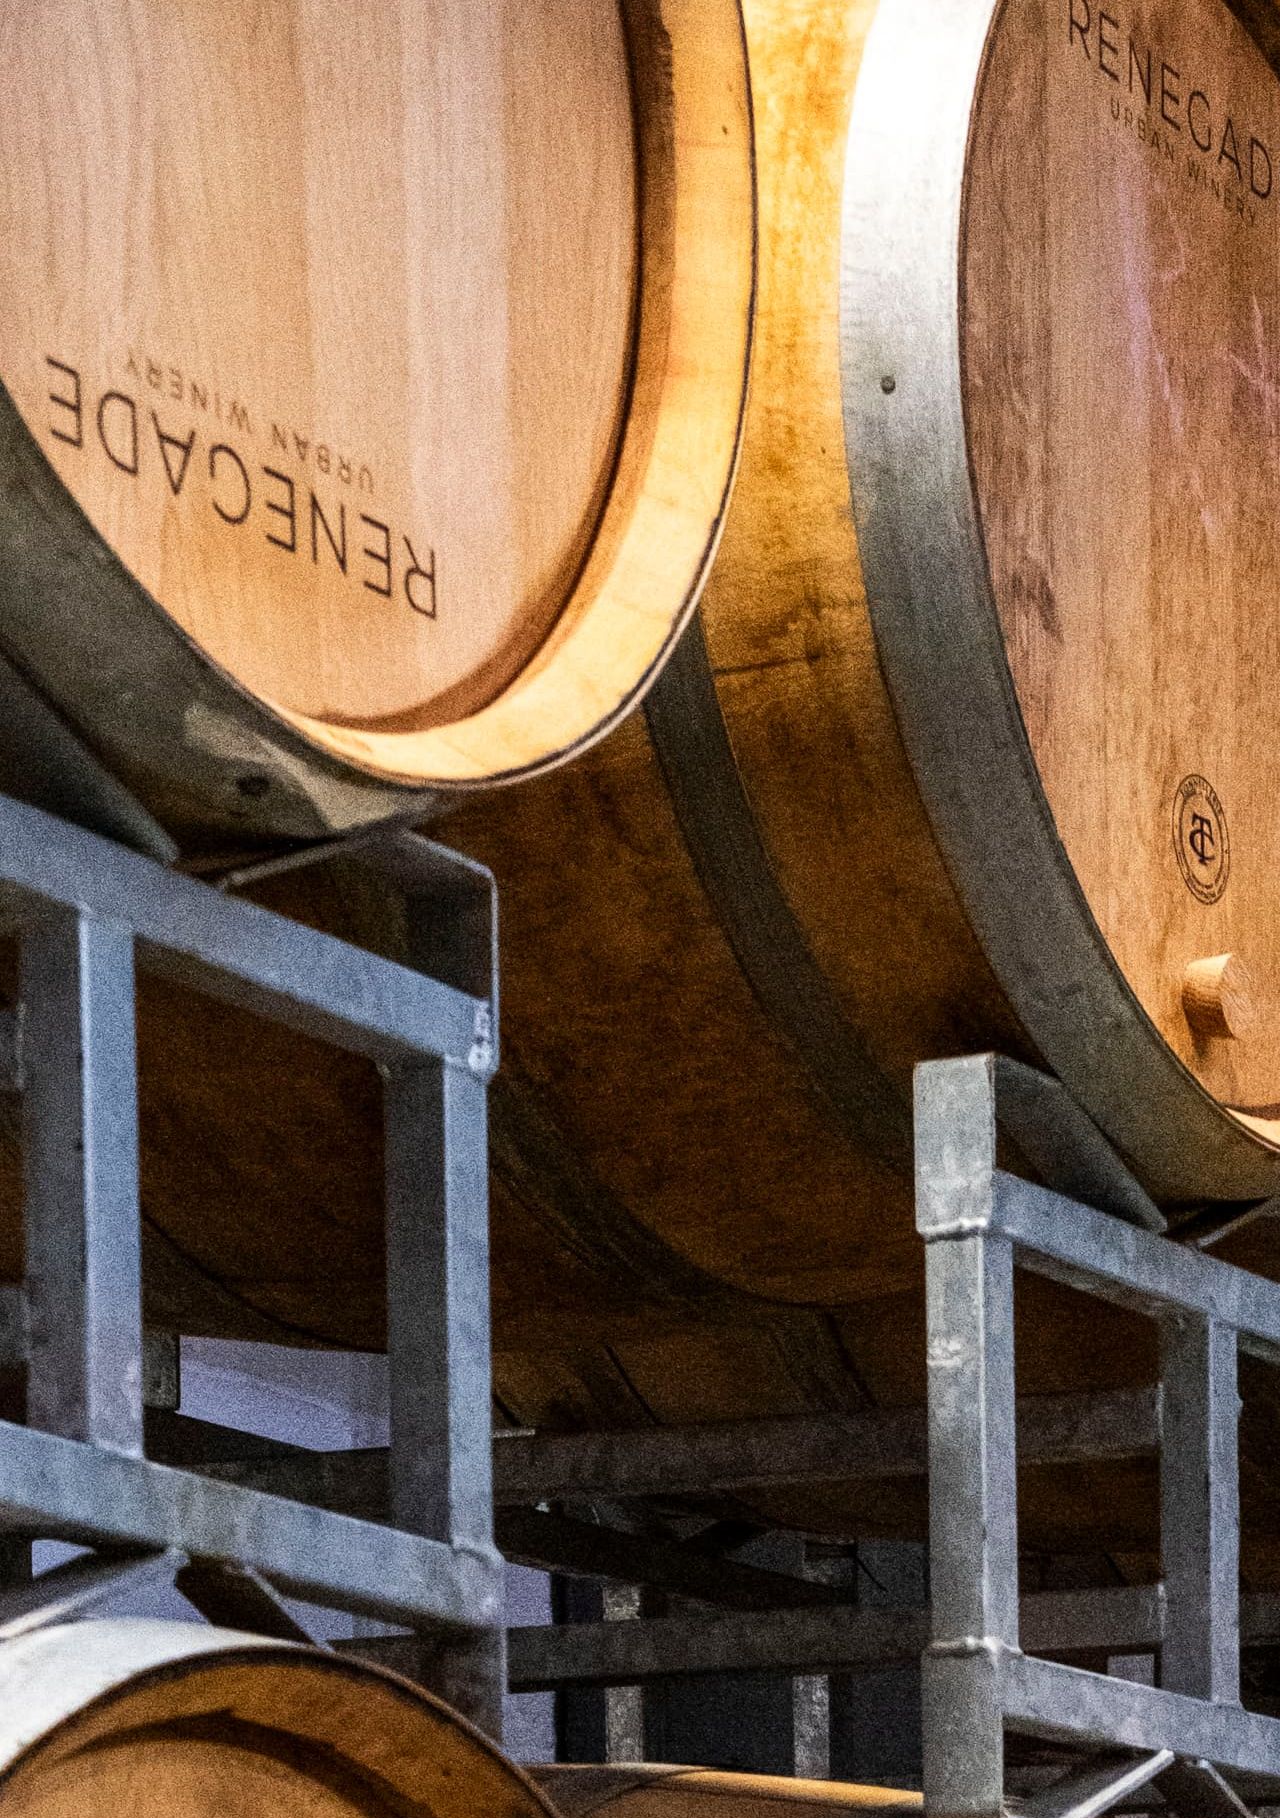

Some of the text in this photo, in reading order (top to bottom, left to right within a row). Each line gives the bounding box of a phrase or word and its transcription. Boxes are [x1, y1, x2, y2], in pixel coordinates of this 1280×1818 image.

[1110, 95, 1174, 163] URBAN
[46, 357, 437, 620] RENEGADE
[123, 350, 376, 495] URBAN WINERY
